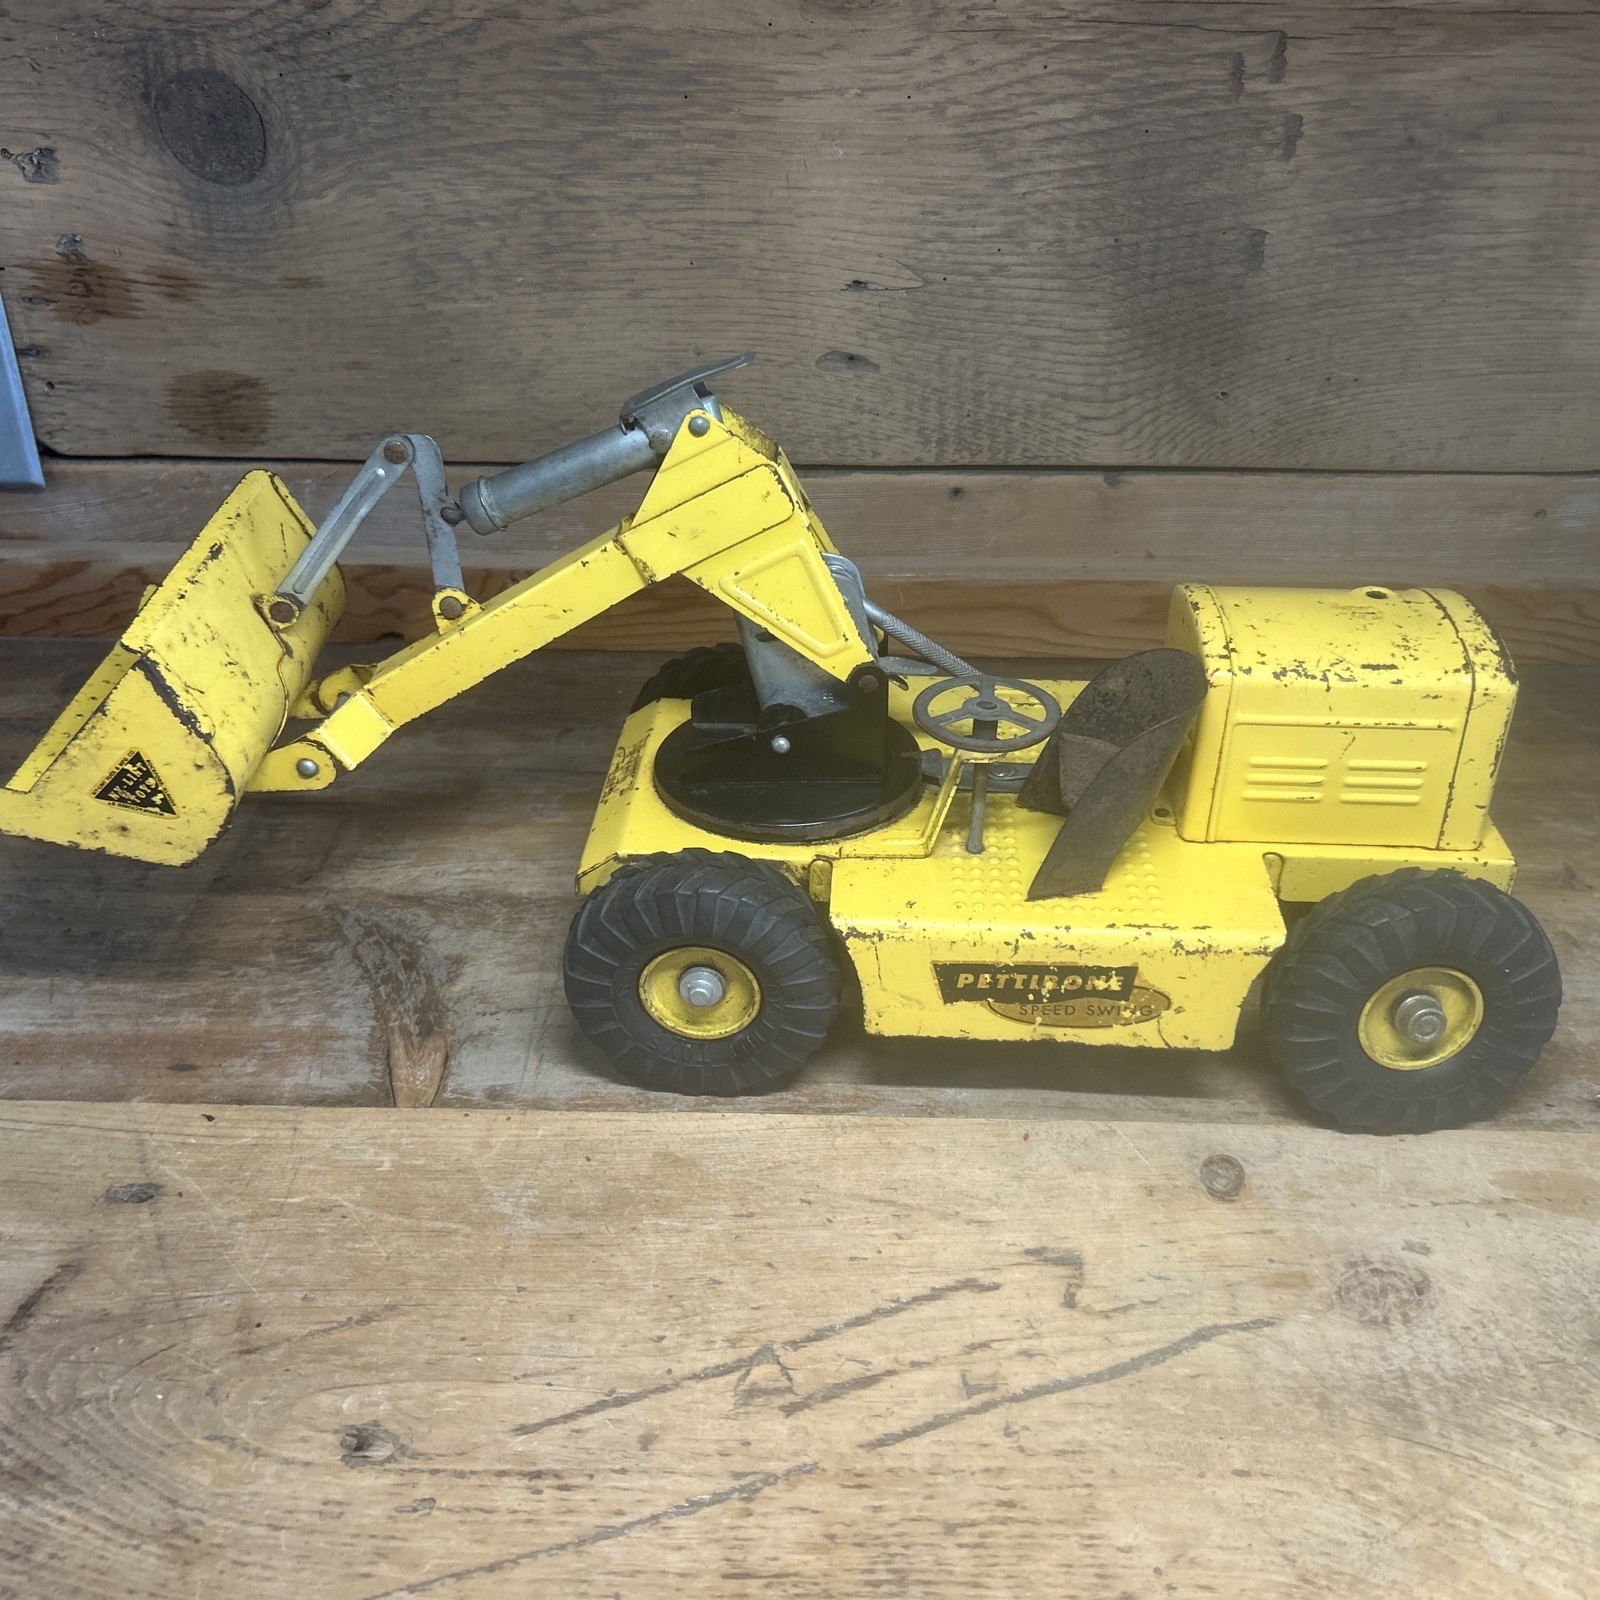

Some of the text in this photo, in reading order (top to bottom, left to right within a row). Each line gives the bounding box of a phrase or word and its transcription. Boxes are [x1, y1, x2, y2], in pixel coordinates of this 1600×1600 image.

[130, 777, 157, 803] TOYS
[956, 971, 1126, 991] PETTIBONE
[1018, 1004, 1153, 1017] SPEED SWING
